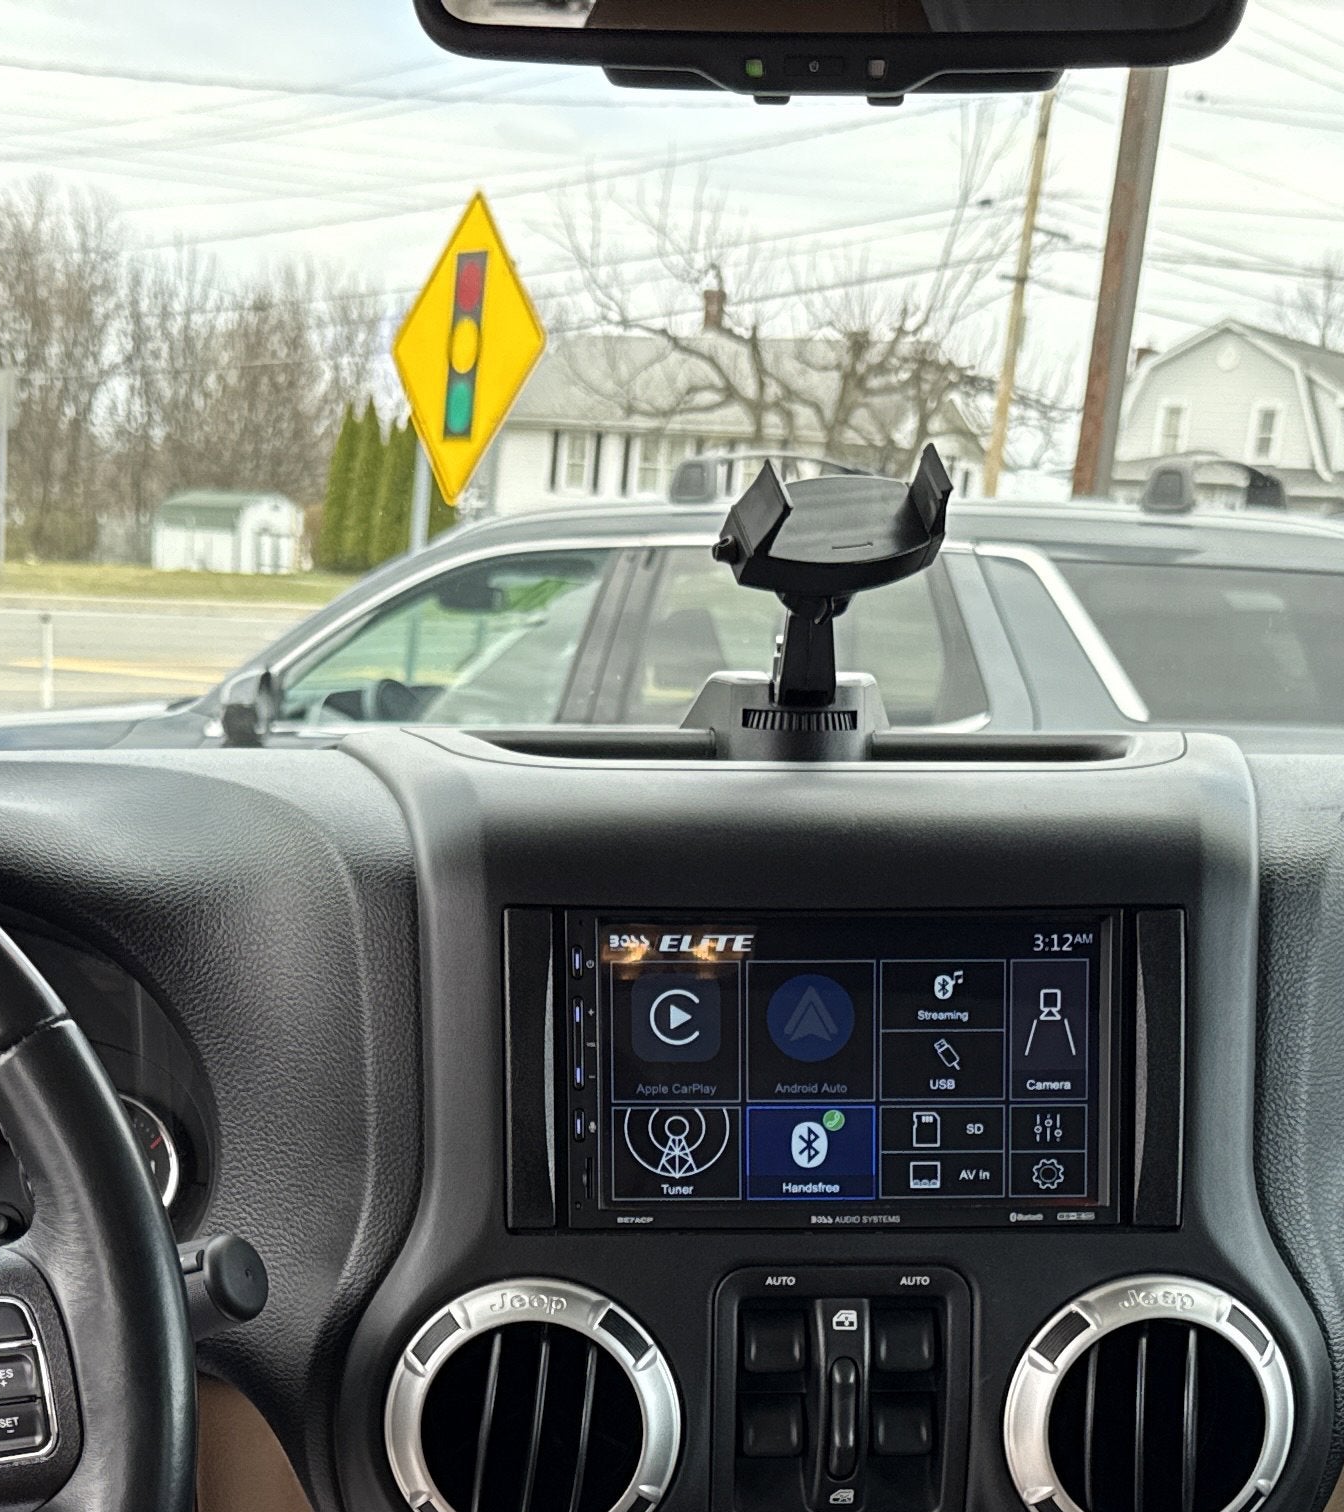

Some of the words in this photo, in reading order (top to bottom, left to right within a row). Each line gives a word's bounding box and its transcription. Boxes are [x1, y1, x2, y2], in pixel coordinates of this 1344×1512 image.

[659, 934, 754, 952] ELITE
[917, 1010, 969, 1022] Streaming
[636, 1084, 668, 1095] Apple
[672, 1084, 717, 1096] CarPlay
[775, 1083, 818, 1094] Android
[821, 1083, 848, 1094] Auto
[929, 1079, 956, 1090] USB
[1026, 1080, 1071, 1091] Camera
[966, 1124, 984, 1135] SD
[959, 1170, 976, 1181] AV
[661, 1184, 694, 1195] Tuner
[782, 1183, 840, 1194] Handsfree
[835, 1215, 860, 1224] AUDIO
[862, 1215, 901, 1224] SYSTEMS
[766, 1276, 796, 1287] AUTO
[900, 1276, 930, 1287] AUTO
[490, 1293, 567, 1314] Jeep
[1119, 1290, 1195, 1312] Jeep
